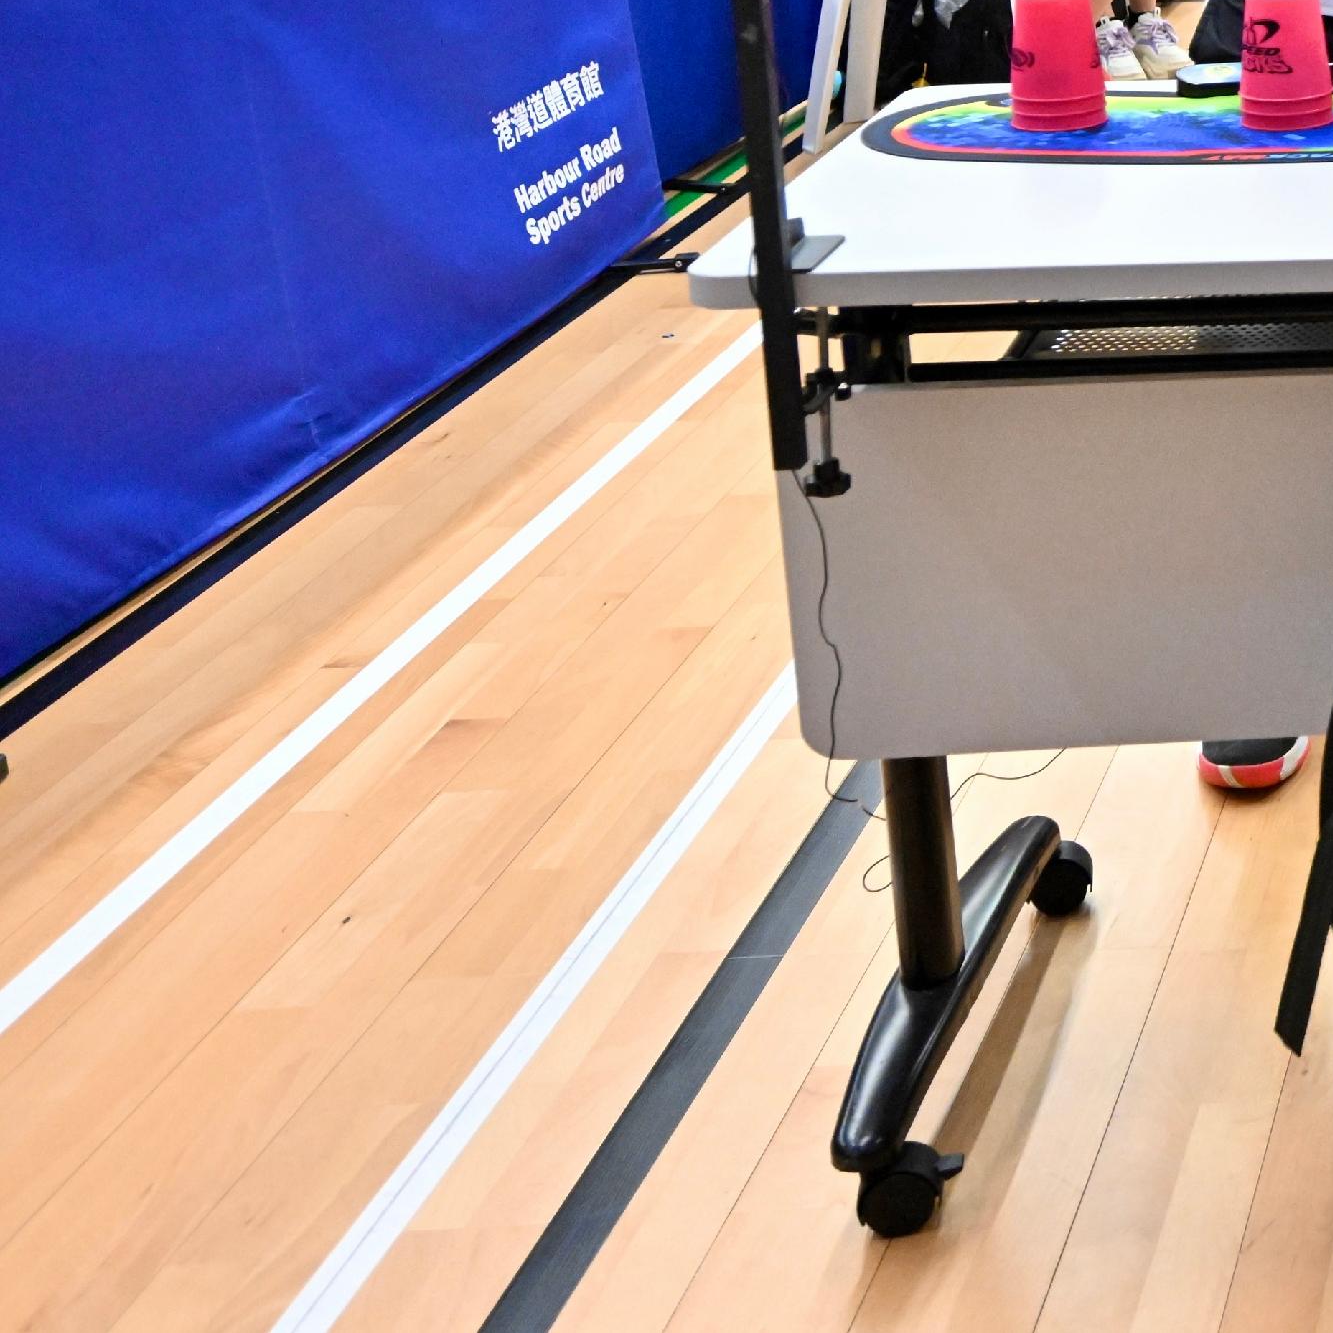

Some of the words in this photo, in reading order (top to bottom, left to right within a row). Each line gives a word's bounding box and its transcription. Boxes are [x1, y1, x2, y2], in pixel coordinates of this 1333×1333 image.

[491, 60, 604, 153] 港灣道體育館
[513, 157, 582, 213] Harbour
[579, 126, 622, 171] Road
[526, 195, 581, 245] Sports
[580, 163, 625, 208] Centre
